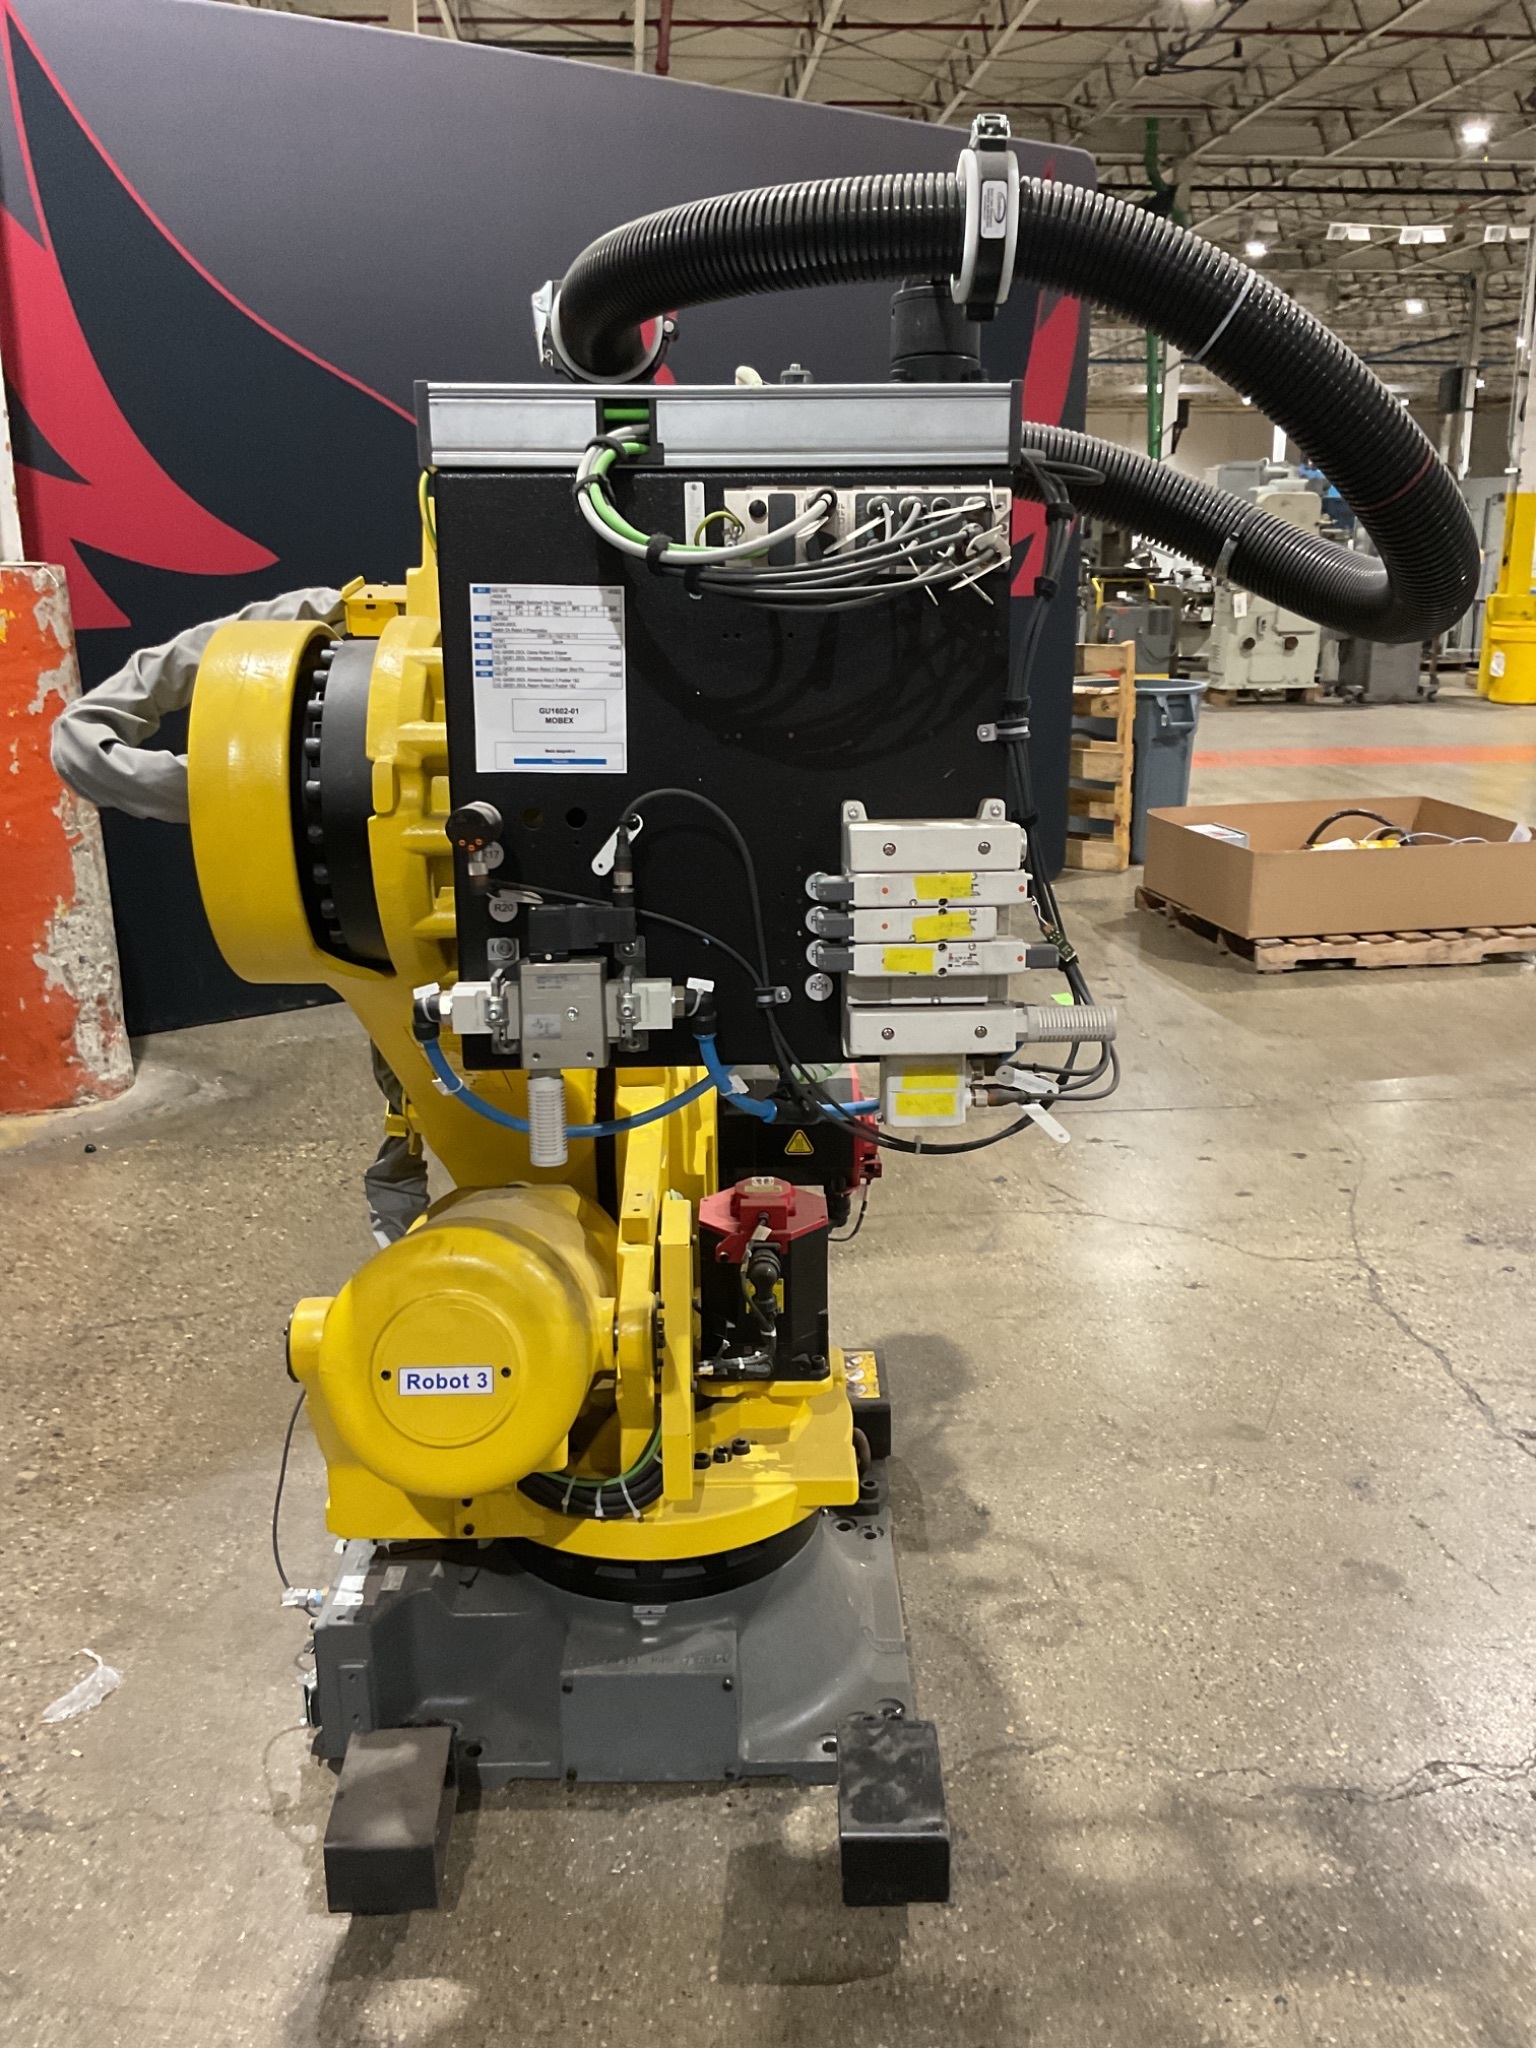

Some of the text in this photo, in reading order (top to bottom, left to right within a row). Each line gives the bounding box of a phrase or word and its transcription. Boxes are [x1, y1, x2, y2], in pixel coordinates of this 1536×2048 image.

[494, 903, 514, 912] R20
[810, 982, 828, 991] R21
[407, 1372, 488, 1390] Robot 3
